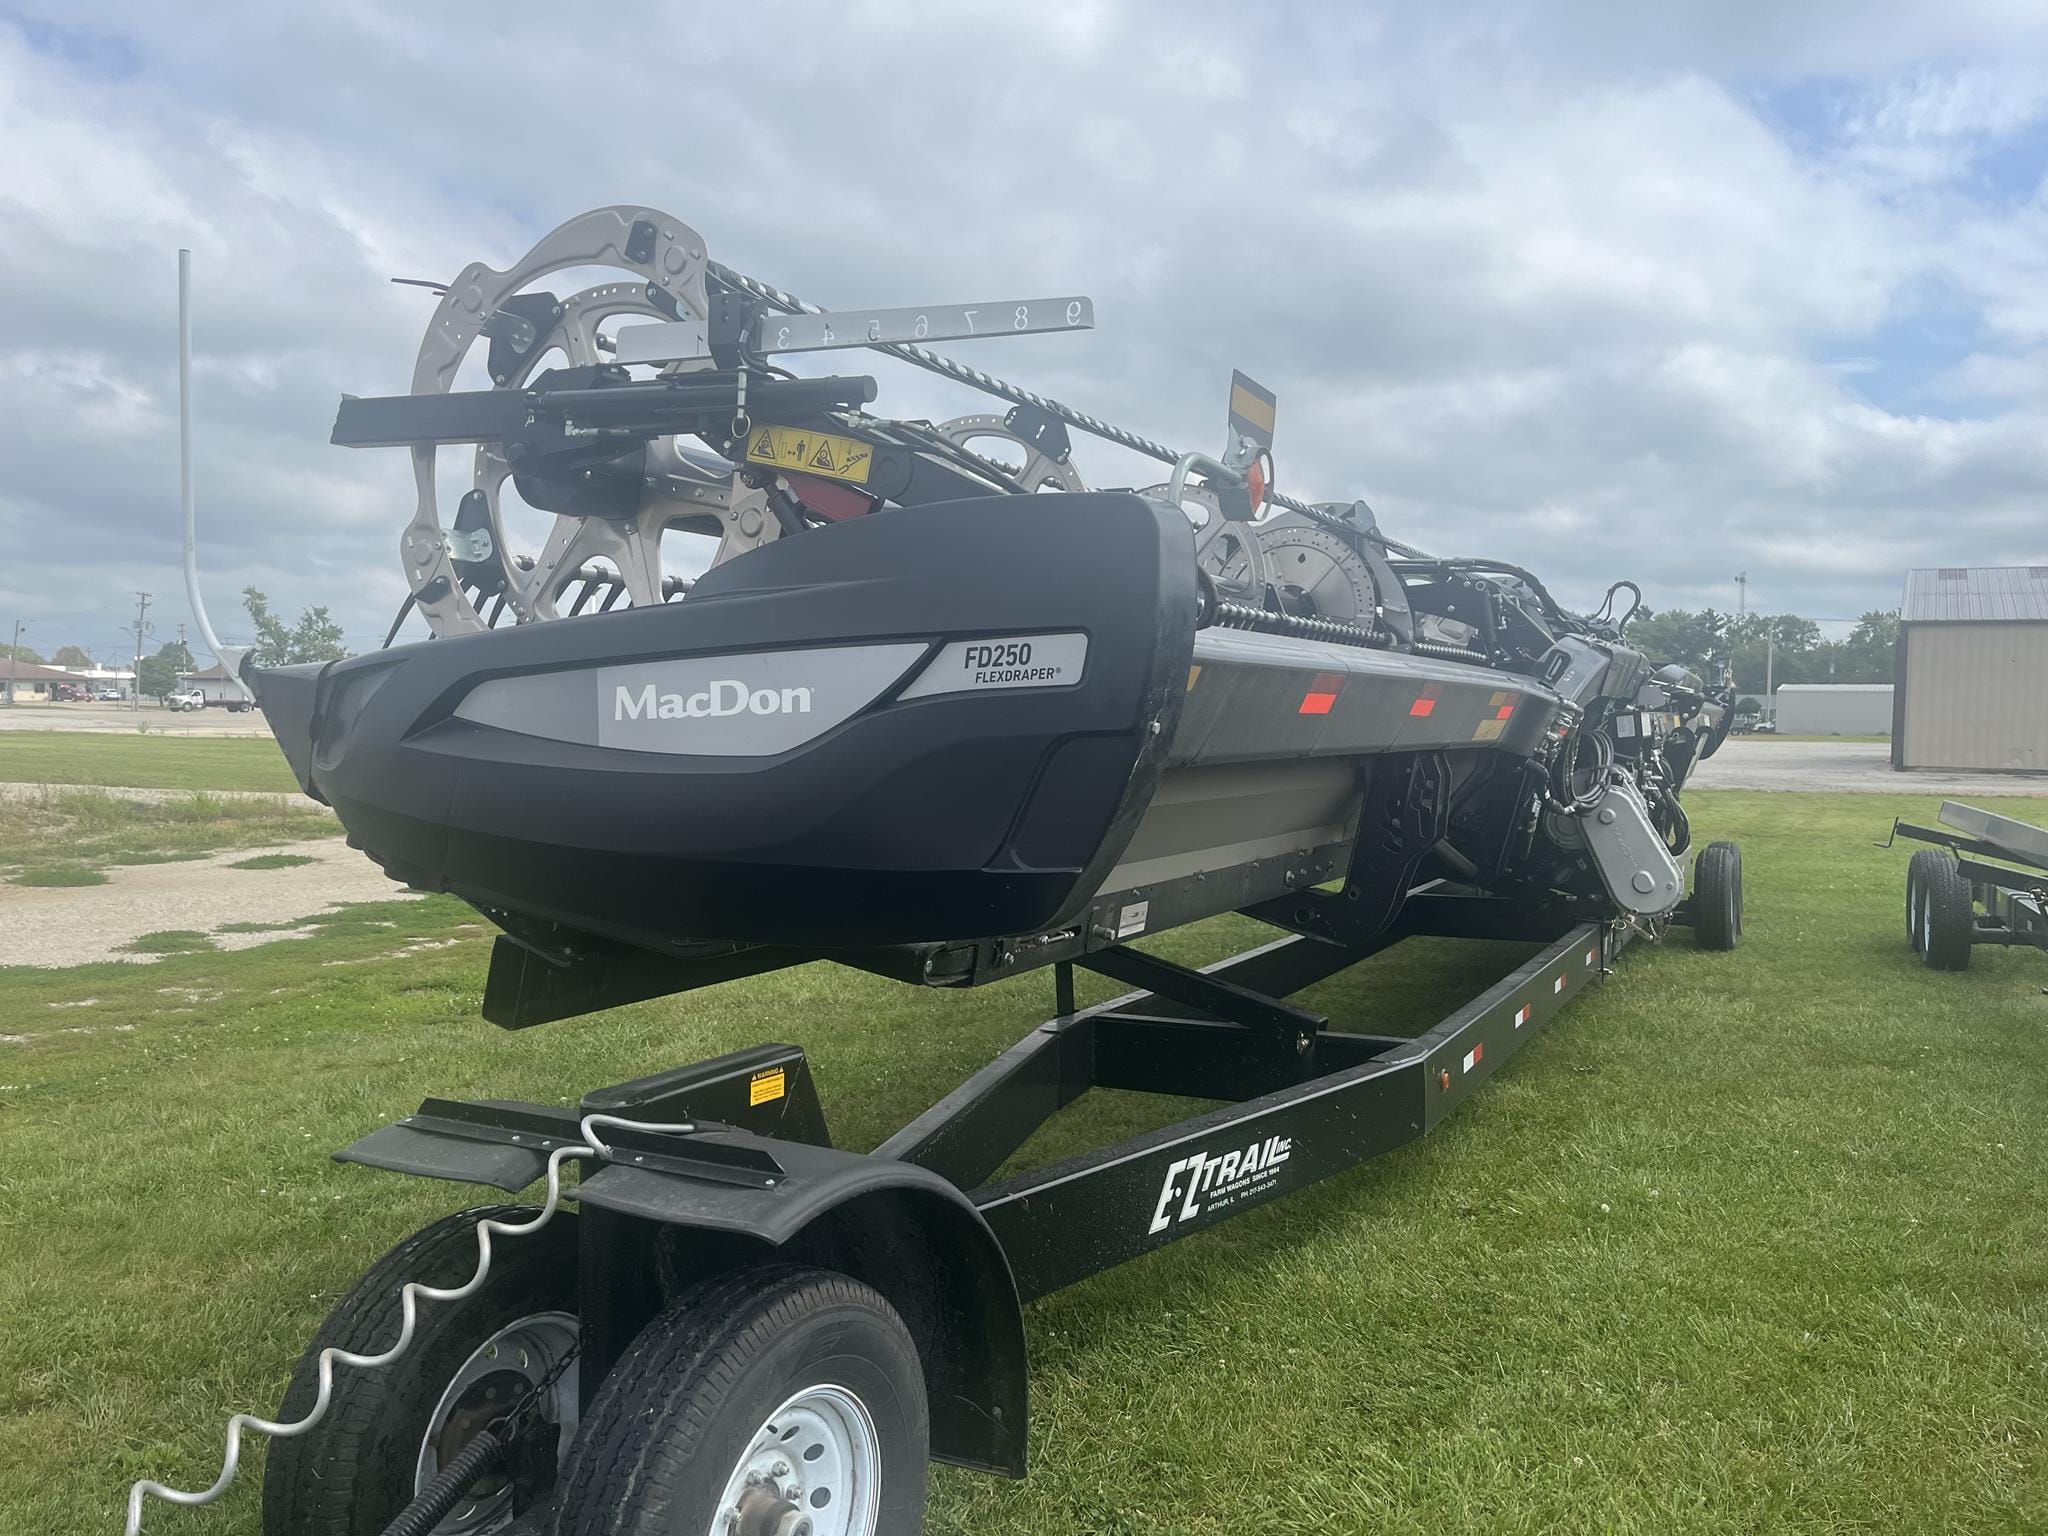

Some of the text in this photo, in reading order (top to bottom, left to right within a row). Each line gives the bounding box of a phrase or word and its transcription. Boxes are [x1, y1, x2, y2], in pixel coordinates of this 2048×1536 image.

[964, 642, 1032, 669] FD250
[614, 680, 812, 721] MacDon
[1201, 1135, 1290, 1192] TRAIL
[1210, 1186, 1226, 1199] FARM
[1226, 1177, 1251, 1193] WAGONS
[1252, 1170, 1268, 1182] SINCE
